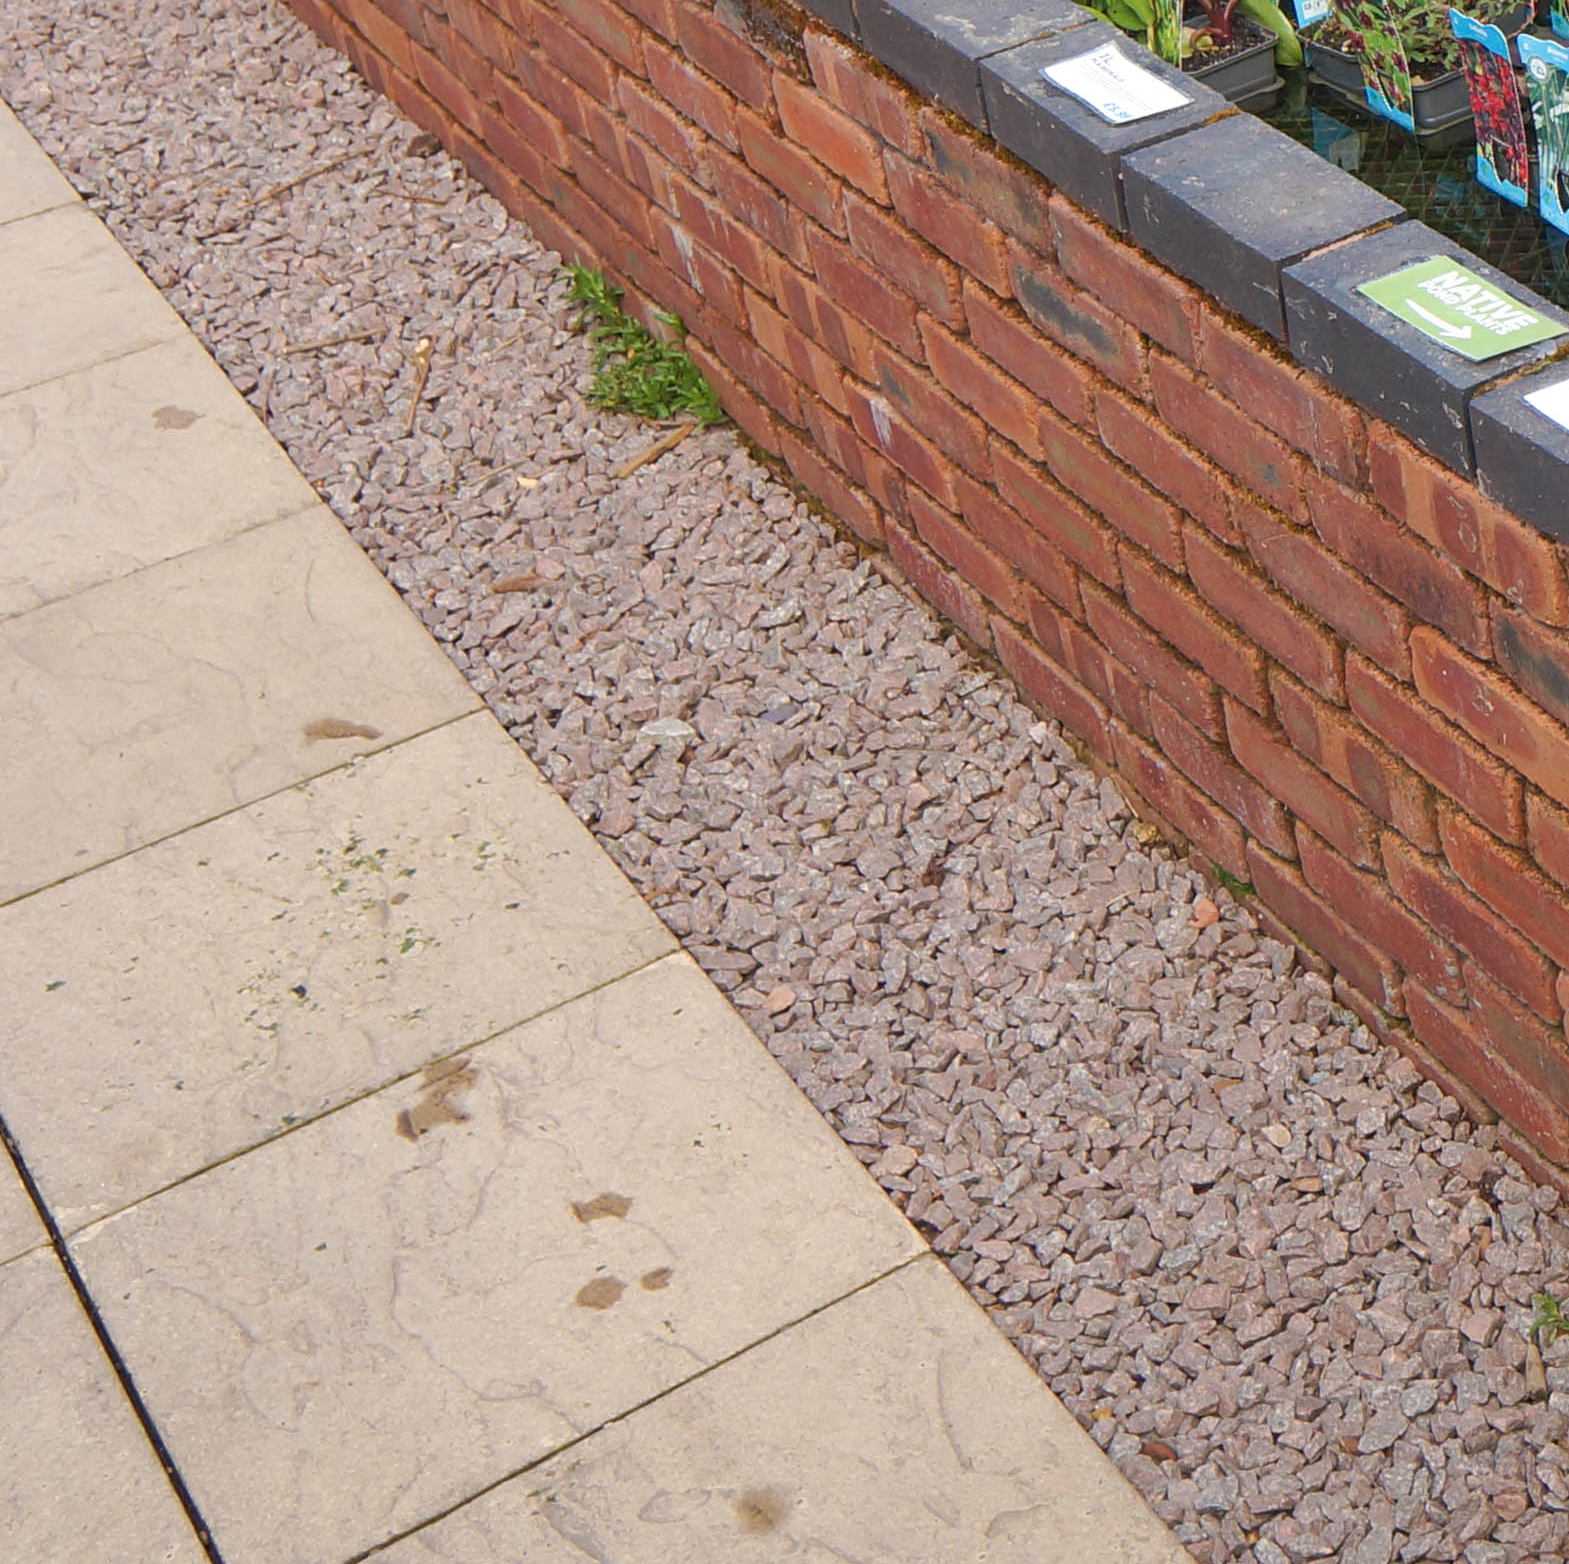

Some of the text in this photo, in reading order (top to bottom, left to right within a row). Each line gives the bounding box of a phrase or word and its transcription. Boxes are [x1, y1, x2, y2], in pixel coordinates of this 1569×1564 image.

[1417, 279, 1513, 336] POND PLANTS
[1431, 270, 1539, 333] NATIVE
